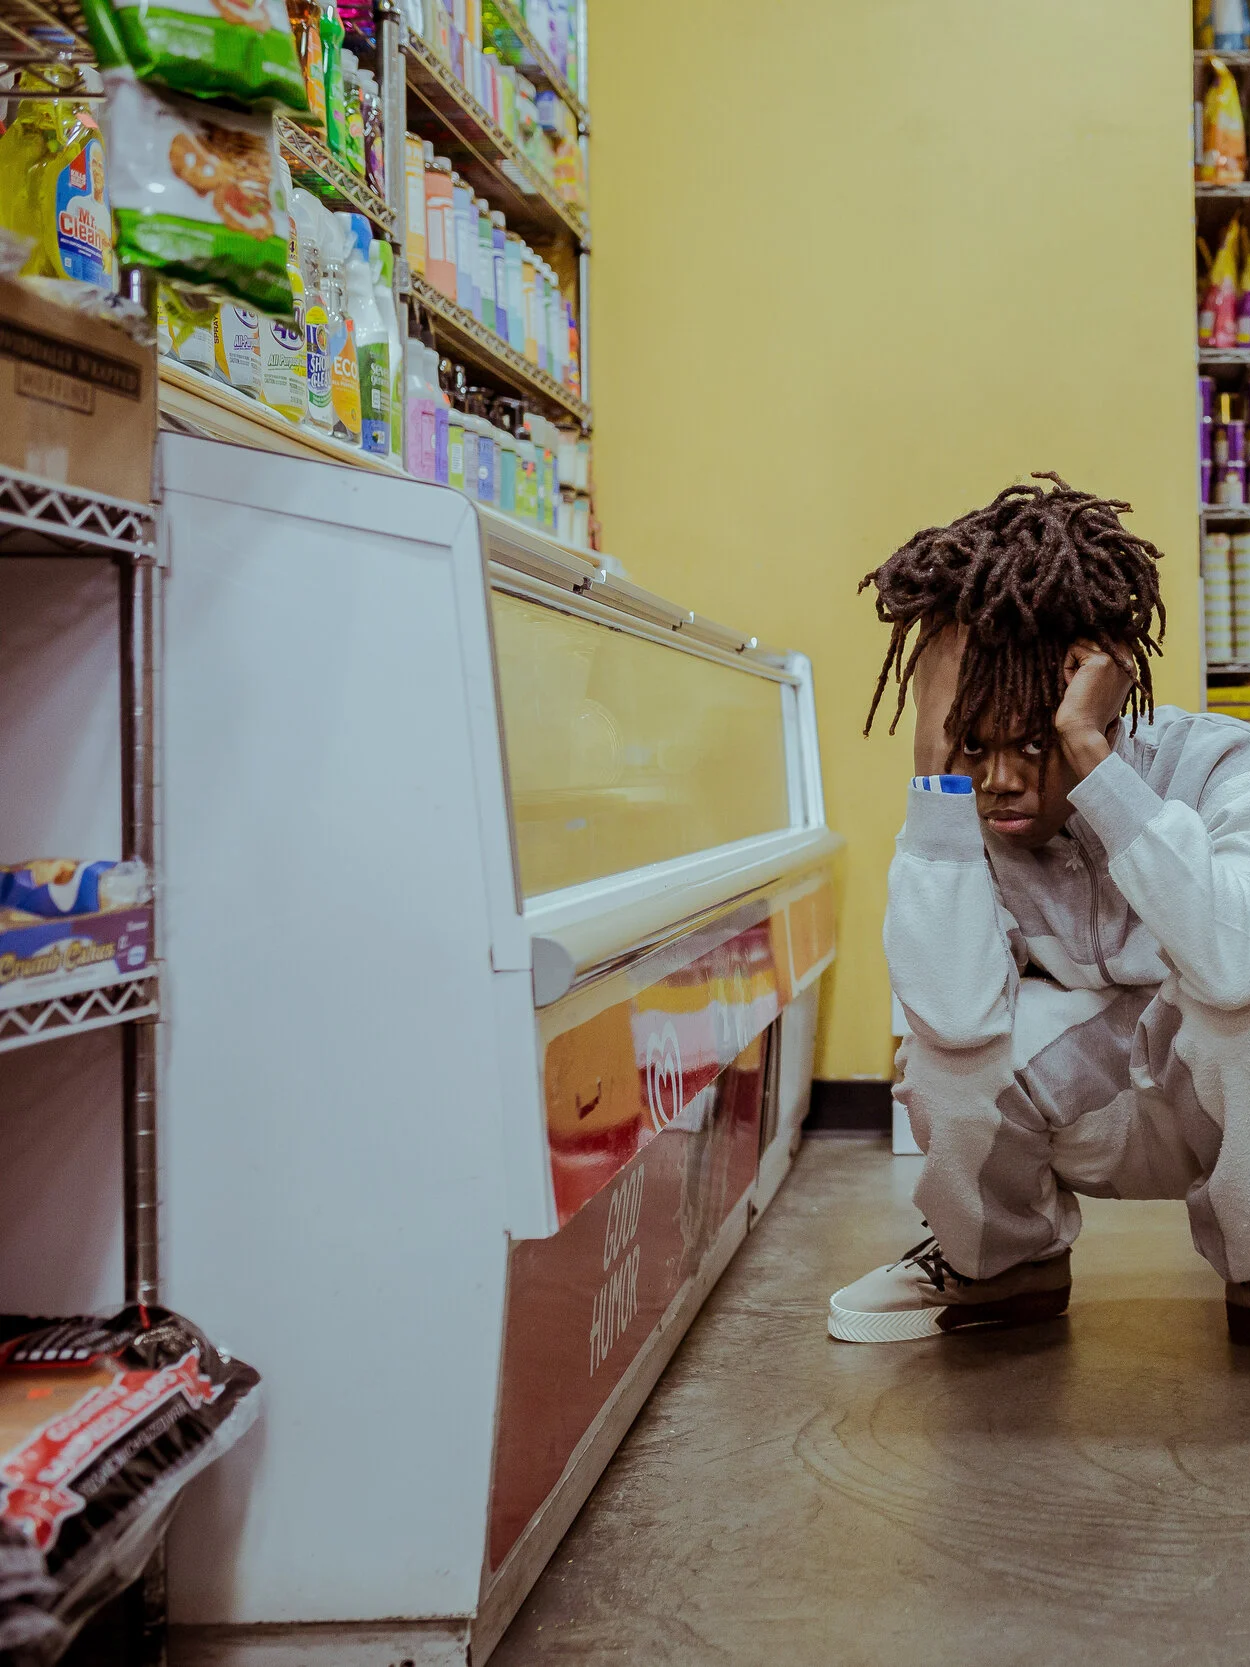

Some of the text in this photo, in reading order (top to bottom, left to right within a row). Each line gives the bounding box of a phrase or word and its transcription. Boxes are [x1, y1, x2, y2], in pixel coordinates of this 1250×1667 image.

[59, 211, 103, 249] Clean
[78, 207, 97, 230] Mr.
[604, 1163, 645, 1272] GOOD
[590, 1243, 640, 1377] HUMOR
